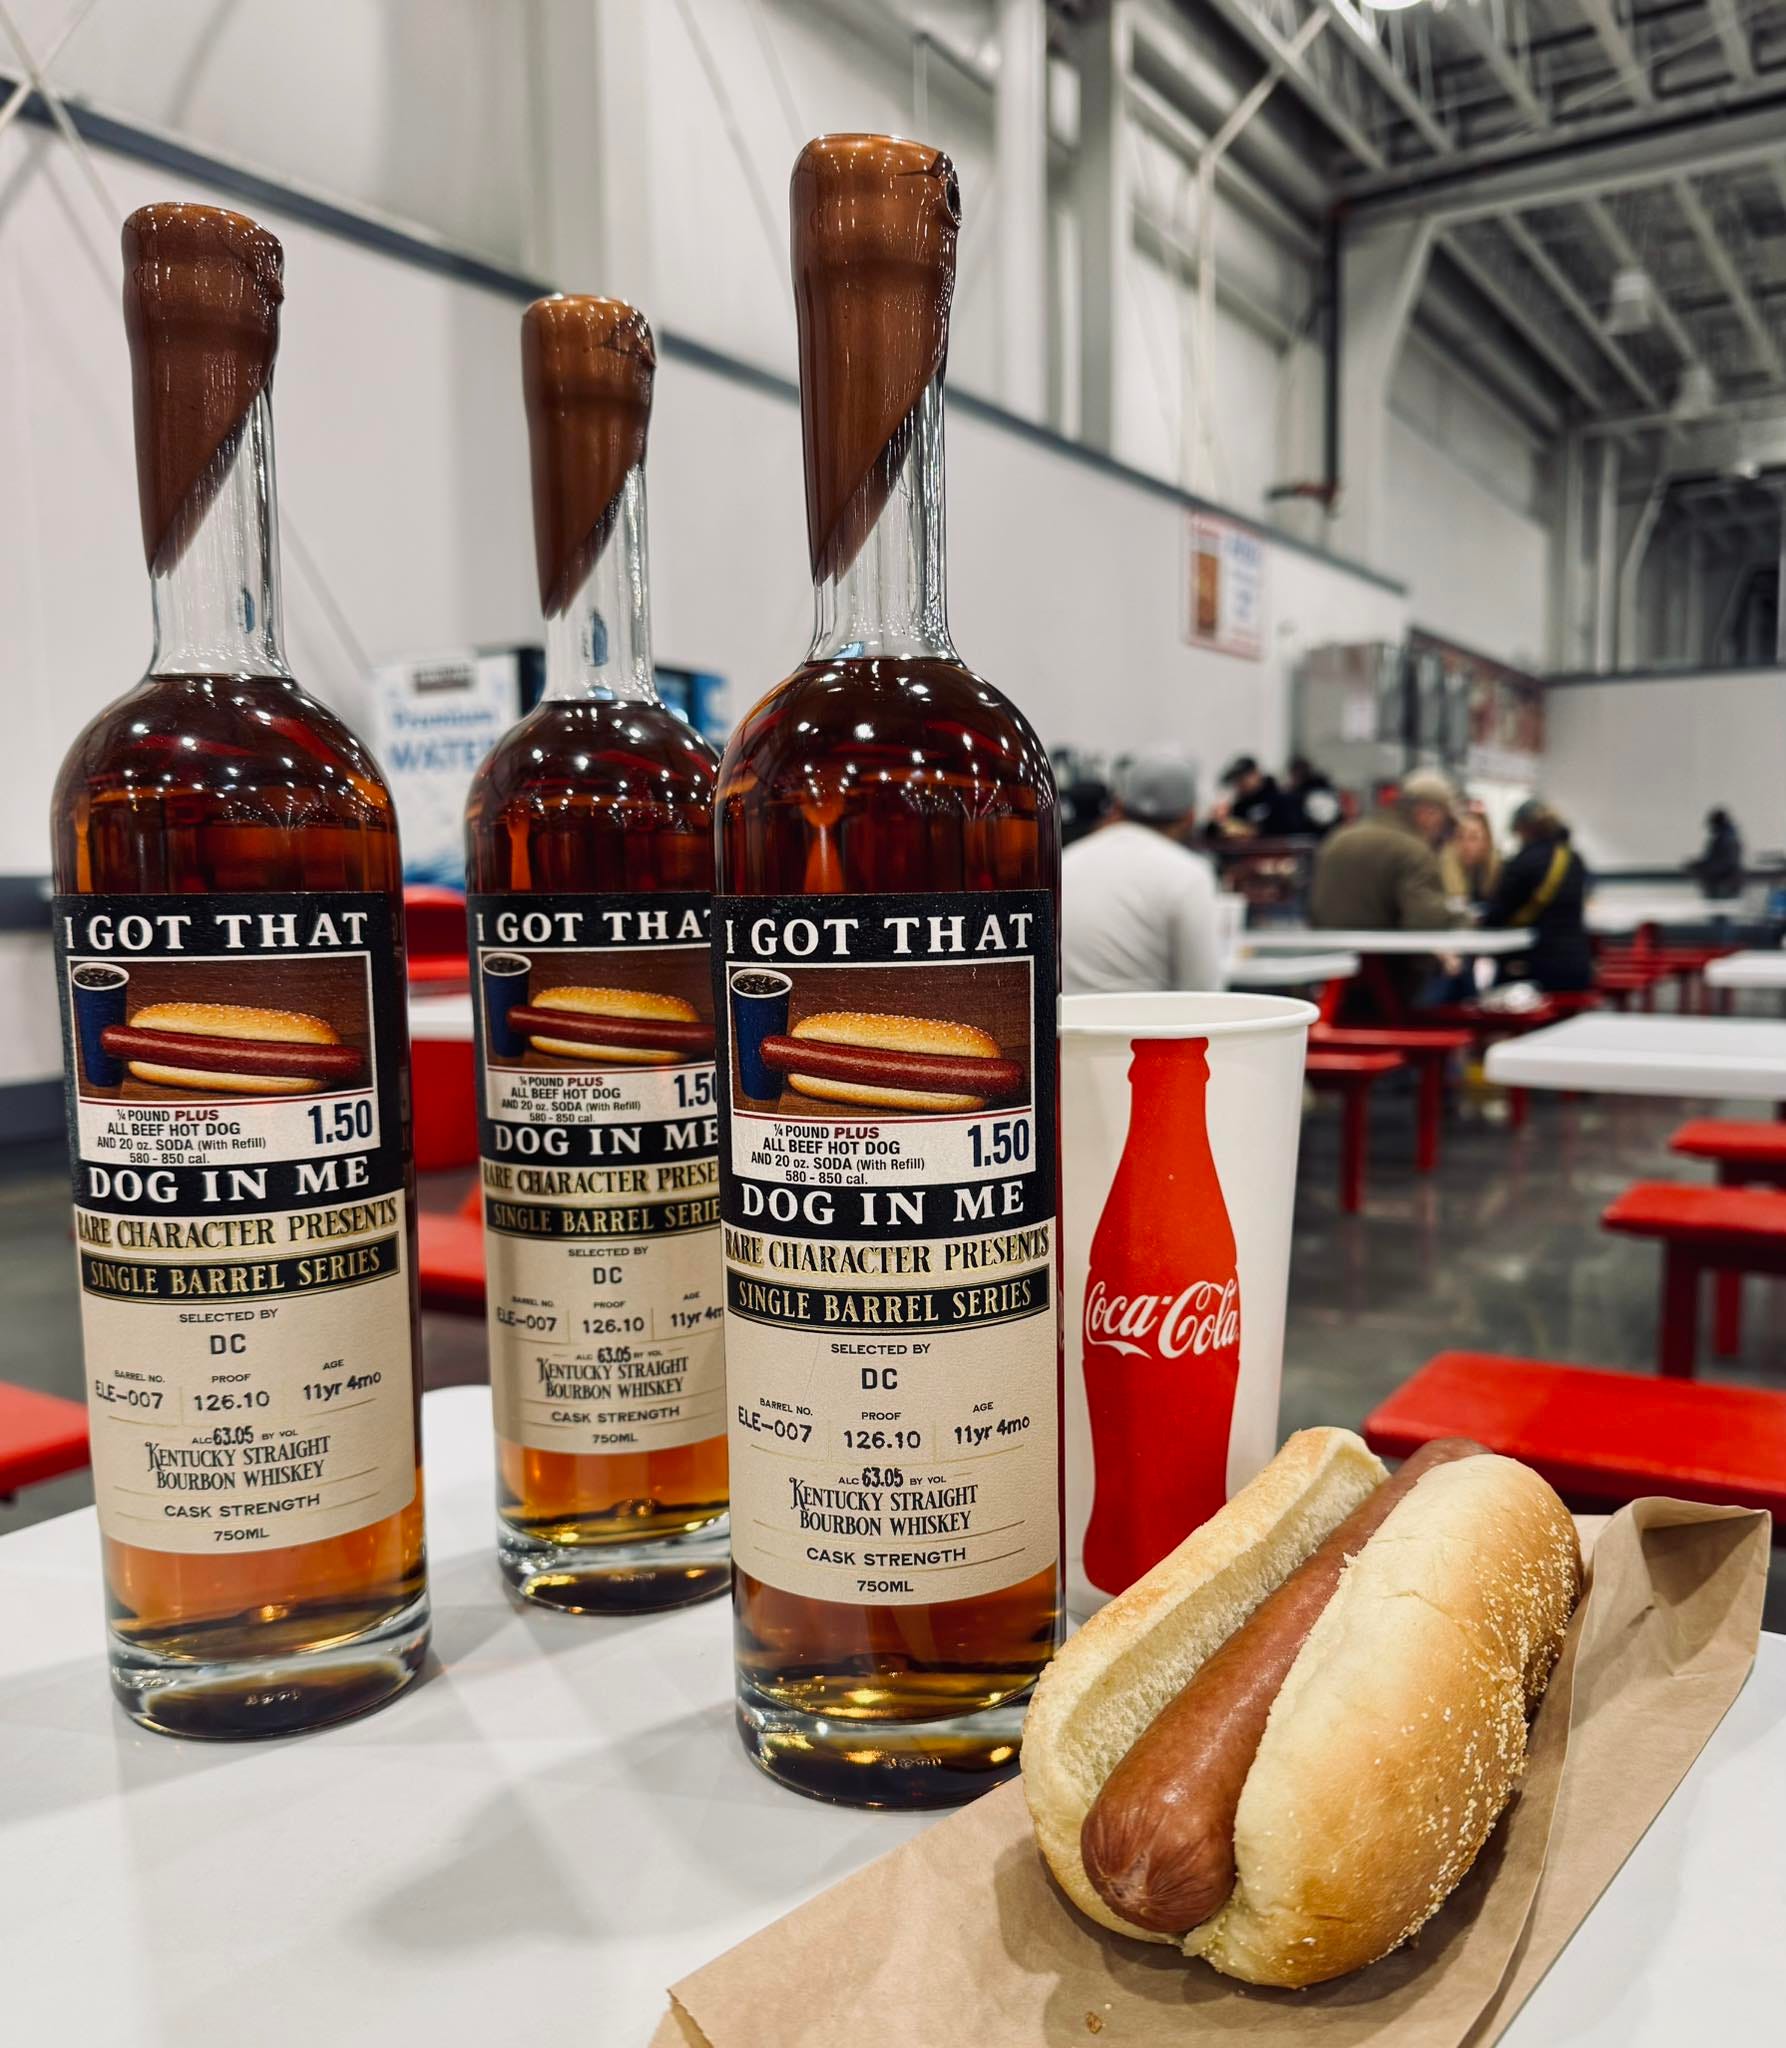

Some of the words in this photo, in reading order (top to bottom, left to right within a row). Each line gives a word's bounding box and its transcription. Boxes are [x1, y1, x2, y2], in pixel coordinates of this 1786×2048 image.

[64, 916, 75, 949] I
[88, 915, 191, 950] GOT
[216, 912, 368, 949] THAT
[476, 913, 484, 941] I
[496, 912, 583, 942] GOT
[725, 920, 734, 954] I
[751, 919, 858, 955] GOT
[884, 913, 1033, 954] THAT
[528, 1077, 564, 1086] POUND
[567, 1077, 604, 1086] PLUS
[511, 1088, 529, 1098] ALL
[531, 1088, 558, 1099] BEEF
[563, 1089, 588, 1099] HOT
[593, 1088, 621, 1099] DOG
[502, 1099, 519, 1109] AND
[521, 1101, 533, 1110] 20
[536, 1103, 548, 1111] oz.
[552, 1101, 582, 1111] SODA
[586, 1102, 610, 1111] (With
[613, 1101, 641, 1111] Refill)
[128, 1110, 170, 1121] POUND
[175, 1110, 219, 1121] PLUS
[307, 1100, 372, 1145] 1.50
[108, 1122, 129, 1135] ALL
[132, 1124, 164, 1136] BEEF
[170, 1124, 201, 1136] HOT
[206, 1123, 241, 1136] DOG
[495, 1125, 570, 1155] DOG
[589, 1128, 642, 1155] IN
[663, 1119, 718, 1150] ME
[785, 1125, 829, 1138] POUND
[834, 1127, 880, 1138] PLUS
[97, 1136, 116, 1148] AND
[119, 1138, 133, 1150] 20
[136, 1141, 152, 1151] oz.
[156, 1139, 194, 1151] SODA
[197, 1139, 228, 1152] (With
[232, 1137, 266, 1150] Refill)
[763, 1137, 785, 1152] ALL
[789, 1139, 823, 1154] BEEF
[828, 1141, 858, 1155] HOT
[865, 1141, 901, 1155] DOG
[967, 1119, 1030, 1167] 1.50
[130, 1153, 150, 1163] 580
[162, 1153, 184, 1164] 850
[188, 1153, 210, 1165] cal.
[751, 1152, 771, 1166] AND
[775, 1155, 789, 1167] 20
[793, 1159, 809, 1168] oz.
[813, 1157, 852, 1170] SODA
[856, 1159, 887, 1171] (With
[891, 1157, 925, 1170] Refill)
[89, 1166, 179, 1203] DOG
[201, 1169, 269, 1202] IN
[295, 1156, 370, 1195] ME
[517, 1166, 649, 1194] CHARACTER
[785, 1170, 807, 1182] 580
[819, 1172, 842, 1183] 850
[846, 1173, 868, 1184] cal.
[742, 1183, 836, 1225] DOG
[860, 1192, 925, 1226] IN
[953, 1180, 1024, 1222] ME
[77, 1212, 113, 1245] RARE
[117, 1219, 276, 1248] CHARACTER
[287, 1197, 397, 1242] PRESENTS
[494, 1204, 552, 1231] SINGLE
[562, 1204, 654, 1233] BARREL
[568, 1248, 629, 1257] SELECTED
[634, 1246, 648, 1254] BY
[724, 1227, 763, 1263] RARE
[769, 1243, 931, 1274] CHARACTER
[945, 1224, 1049, 1271] PRESENTS
[91, 1260, 159, 1294] SINGLE
[171, 1263, 285, 1296] BARREL
[298, 1246, 380, 1284] SERIES
[592, 1267, 623, 1284] DC
[594, 1300, 625, 1308] PROOF
[739, 1280, 811, 1319] SINGLE
[823, 1294, 939, 1323] BARREL
[952, 1279, 1032, 1319] SERIES
[179, 1310, 255, 1323] SELECTED
[260, 1309, 278, 1320] BY
[583, 1317, 644, 1333] 126.10
[671, 1312, 702, 1328] 11yr
[1085, 1278, 1239, 1359] Coca-Cola
[209, 1334, 247, 1355] DC
[831, 1343, 908, 1355] SELECTED
[913, 1343, 931, 1354] BY
[597, 1346, 630, 1363] 63.05
[322, 1359, 345, 1370] AGE
[536, 1358, 611, 1383] KENTUCKY
[619, 1357, 689, 1378] STRAIGHT
[114, 1370, 146, 1381] BARREL
[148, 1374, 165, 1383] NO.
[212, 1373, 251, 1383] PROOF
[861, 1368, 899, 1390] DC
[303, 1382, 343, 1401] 11yr
[346, 1372, 381, 1389] 4mo
[546, 1381, 611, 1399] BOURBON
[619, 1378, 684, 1397] WHISKEY
[194, 1390, 270, 1410] 126.10
[760, 1397, 794, 1413] BARREL
[796, 1406, 813, 1416] NO.
[972, 1402, 994, 1413] AGE
[552, 1412, 591, 1422] CASK
[597, 1407, 680, 1422] STRENGTH
[738, 1405, 813, 1443] ELE-007
[861, 1411, 902, 1420] PROOF
[213, 1426, 254, 1445] 63.05
[592, 1433, 639, 1444] 750ML
[843, 1430, 922, 1449] 126.10
[954, 1420, 992, 1447] 11yr
[996, 1416, 1030, 1435] 4mo
[144, 1442, 236, 1472] KENTUCKY
[244, 1436, 331, 1466] STRAIGHT
[156, 1470, 236, 1490] BOURBON
[244, 1460, 325, 1488] WHISKEY
[838, 1477, 860, 1485] ALC
[861, 1467, 904, 1488] 63.05
[909, 1477, 923, 1485] BY
[927, 1475, 947, 1484] VOL
[789, 1477, 882, 1511] KENTUCKY
[890, 1485, 979, 1511] STRAIGHT
[164, 1505, 211, 1518] CASK
[220, 1494, 320, 1517] STRENGTH
[800, 1508, 881, 1536] BOURBON
[890, 1511, 972, 1536] WHISKEY
[213, 1529, 270, 1541] 750ML
[806, 1548, 856, 1566] CASK
[864, 1548, 966, 1566] STRENGTH
[857, 1580, 914, 1592] 750ML
